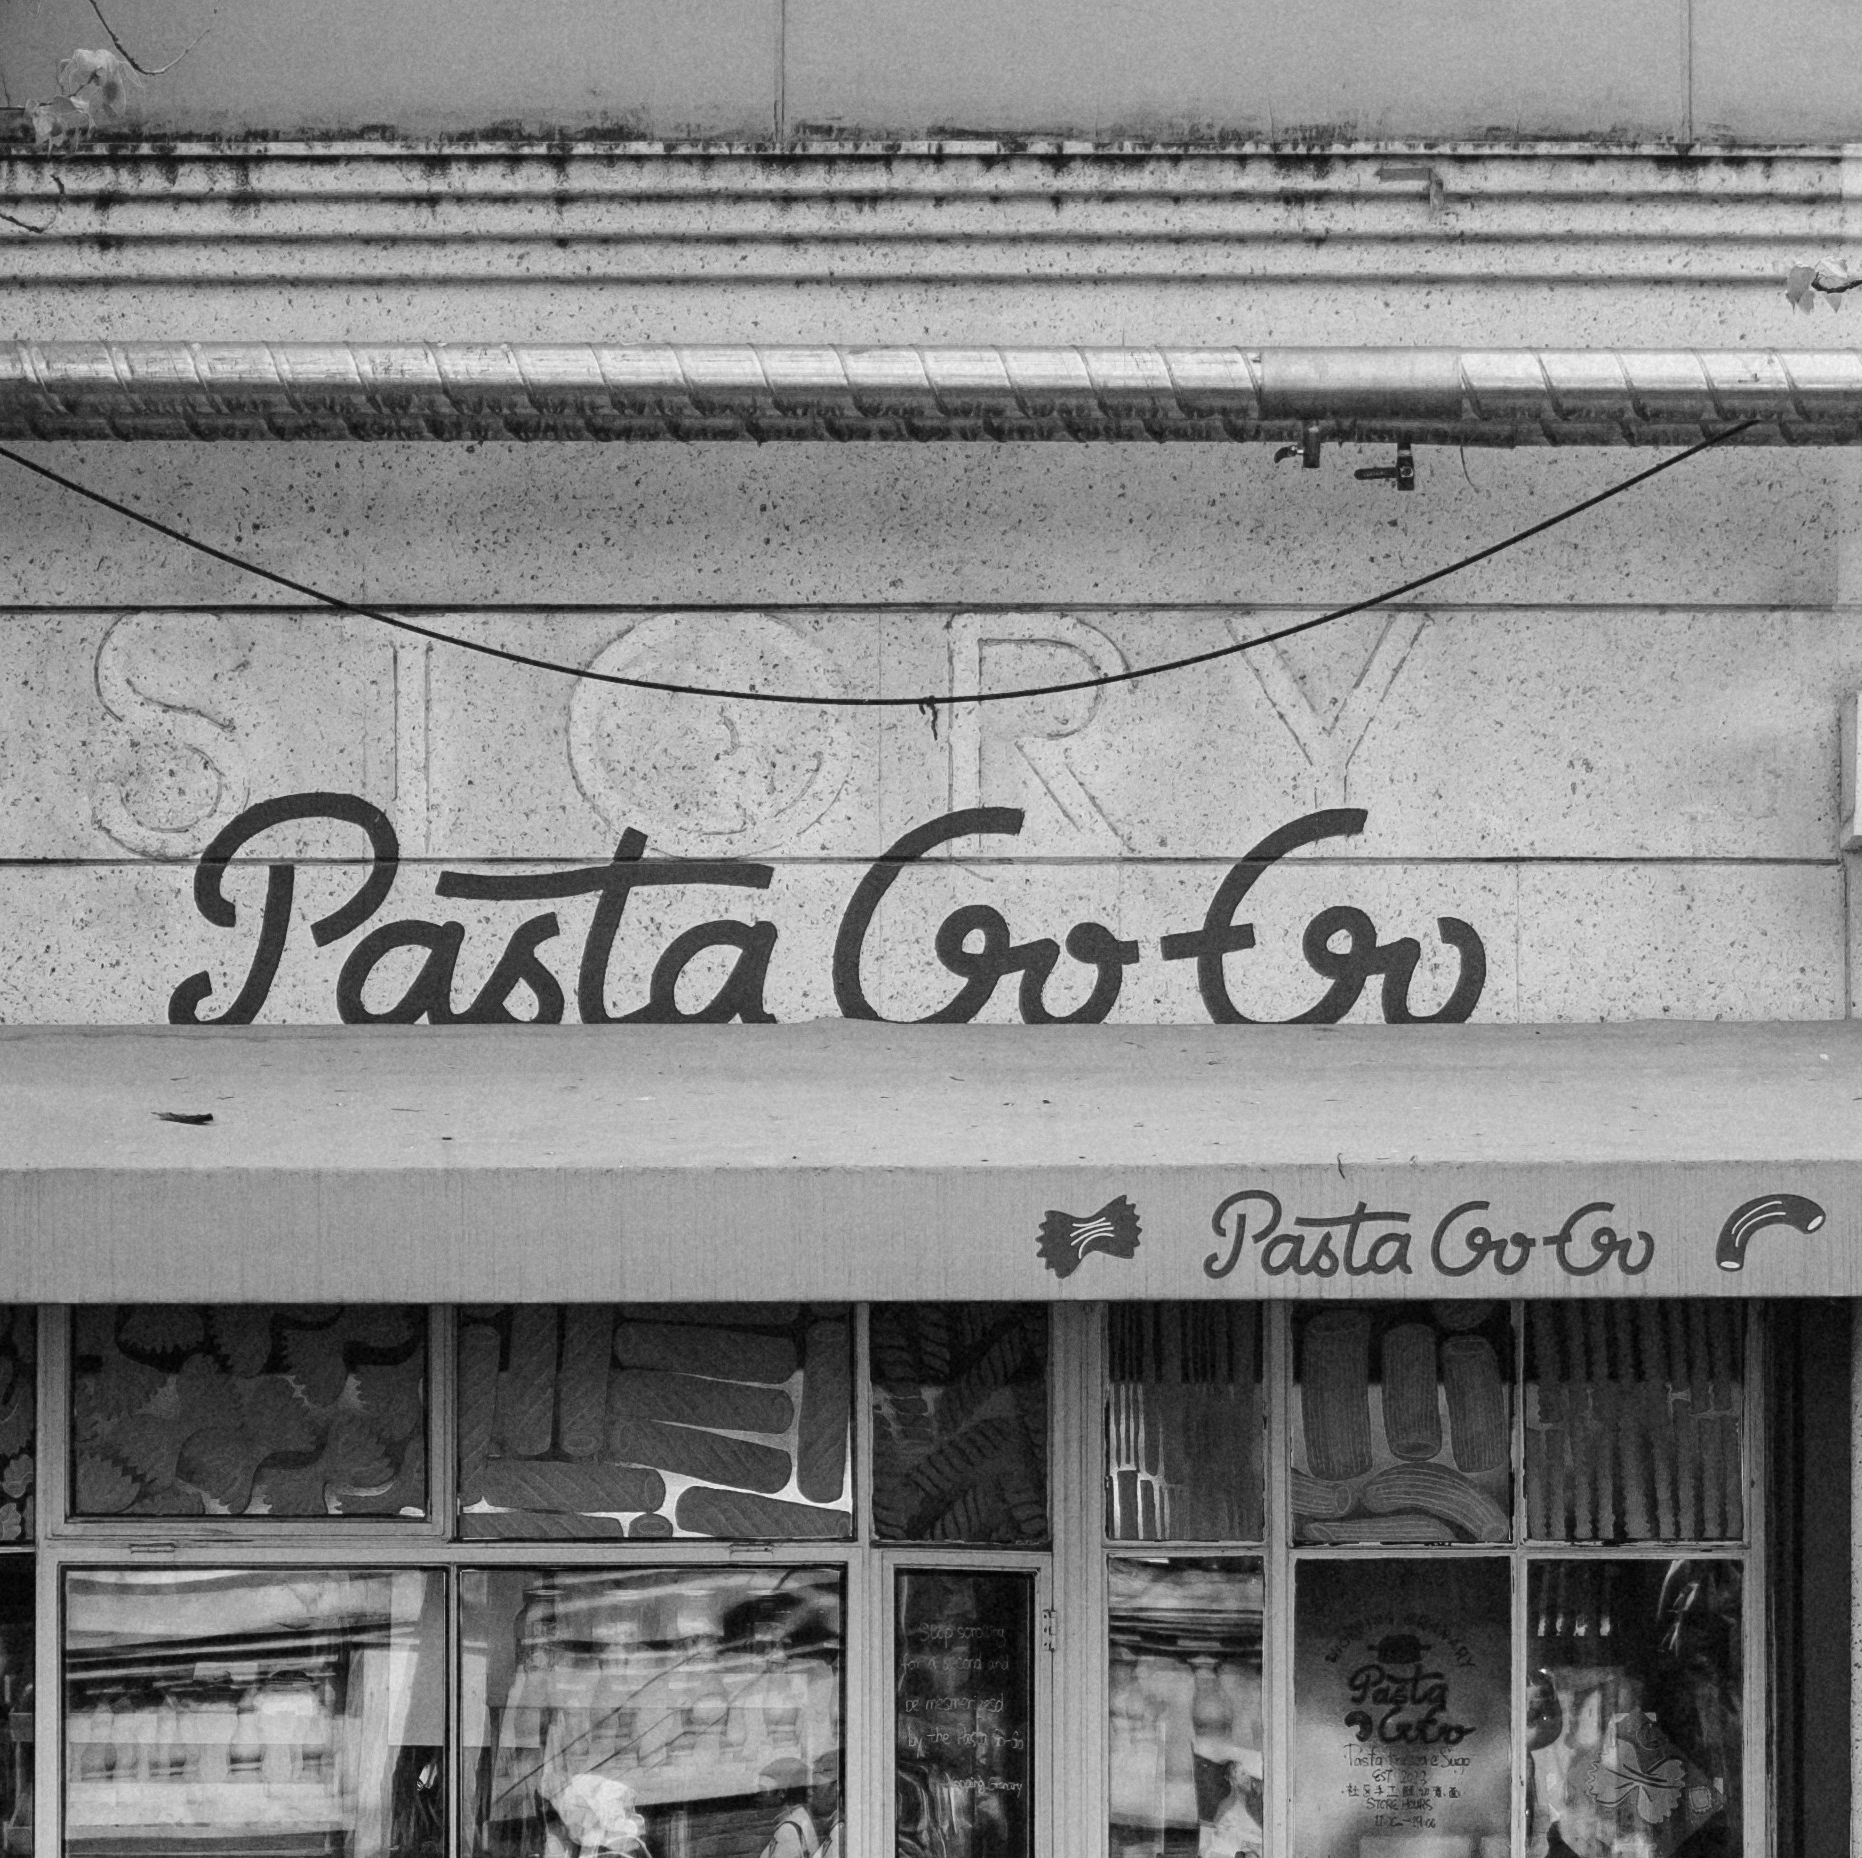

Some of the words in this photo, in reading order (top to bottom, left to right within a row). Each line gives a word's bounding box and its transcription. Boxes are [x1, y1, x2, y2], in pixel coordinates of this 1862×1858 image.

[168, 791, 778, 1025] Pasta
[1202, 1189, 1413, 1281] Pasta
[1348, 1664, 1449, 1706] Pasta
